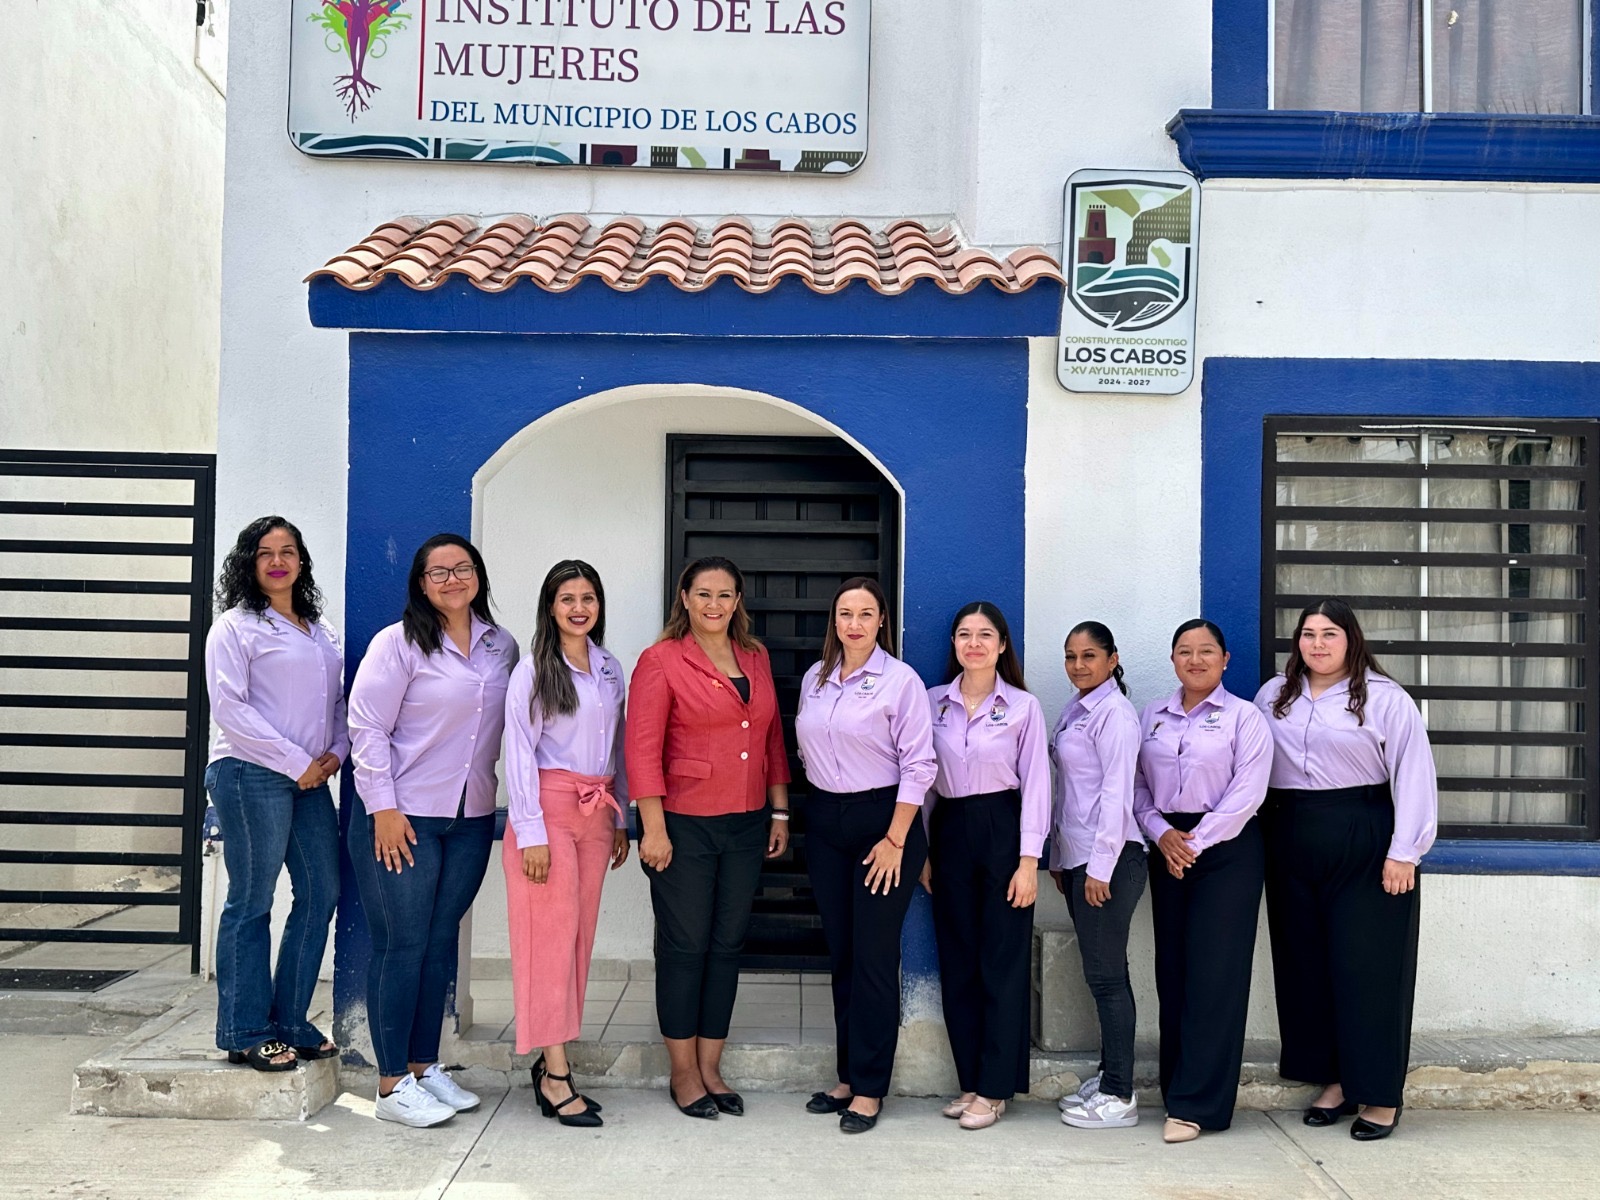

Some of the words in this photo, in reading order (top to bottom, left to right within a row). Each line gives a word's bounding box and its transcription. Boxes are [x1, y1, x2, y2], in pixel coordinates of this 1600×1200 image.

[435, 0, 680, 31] INSTITUTO
[693, 0, 752, 33] DE
[764, 1, 846, 36] LAS
[433, 42, 640, 85] MUJERES
[429, 100, 485, 124] DEL
[493, 103, 652, 130] MUNICIPIO
[660, 109, 698, 131] DE
[705, 110, 758, 133] LOS
[765, 112, 858, 135] CABOS
[1065, 336, 1144, 346] CONSTRUYENDO
[1144, 338, 1188, 347] CONTIGO
[1064, 347, 1107, 363] LOS
[1110, 348, 1187, 366] CABOS
[1070, 366, 1088, 375] XV
[1088, 366, 1179, 377] AYUNTAMIENTO
[1098, 378, 1121, 386] 2024
